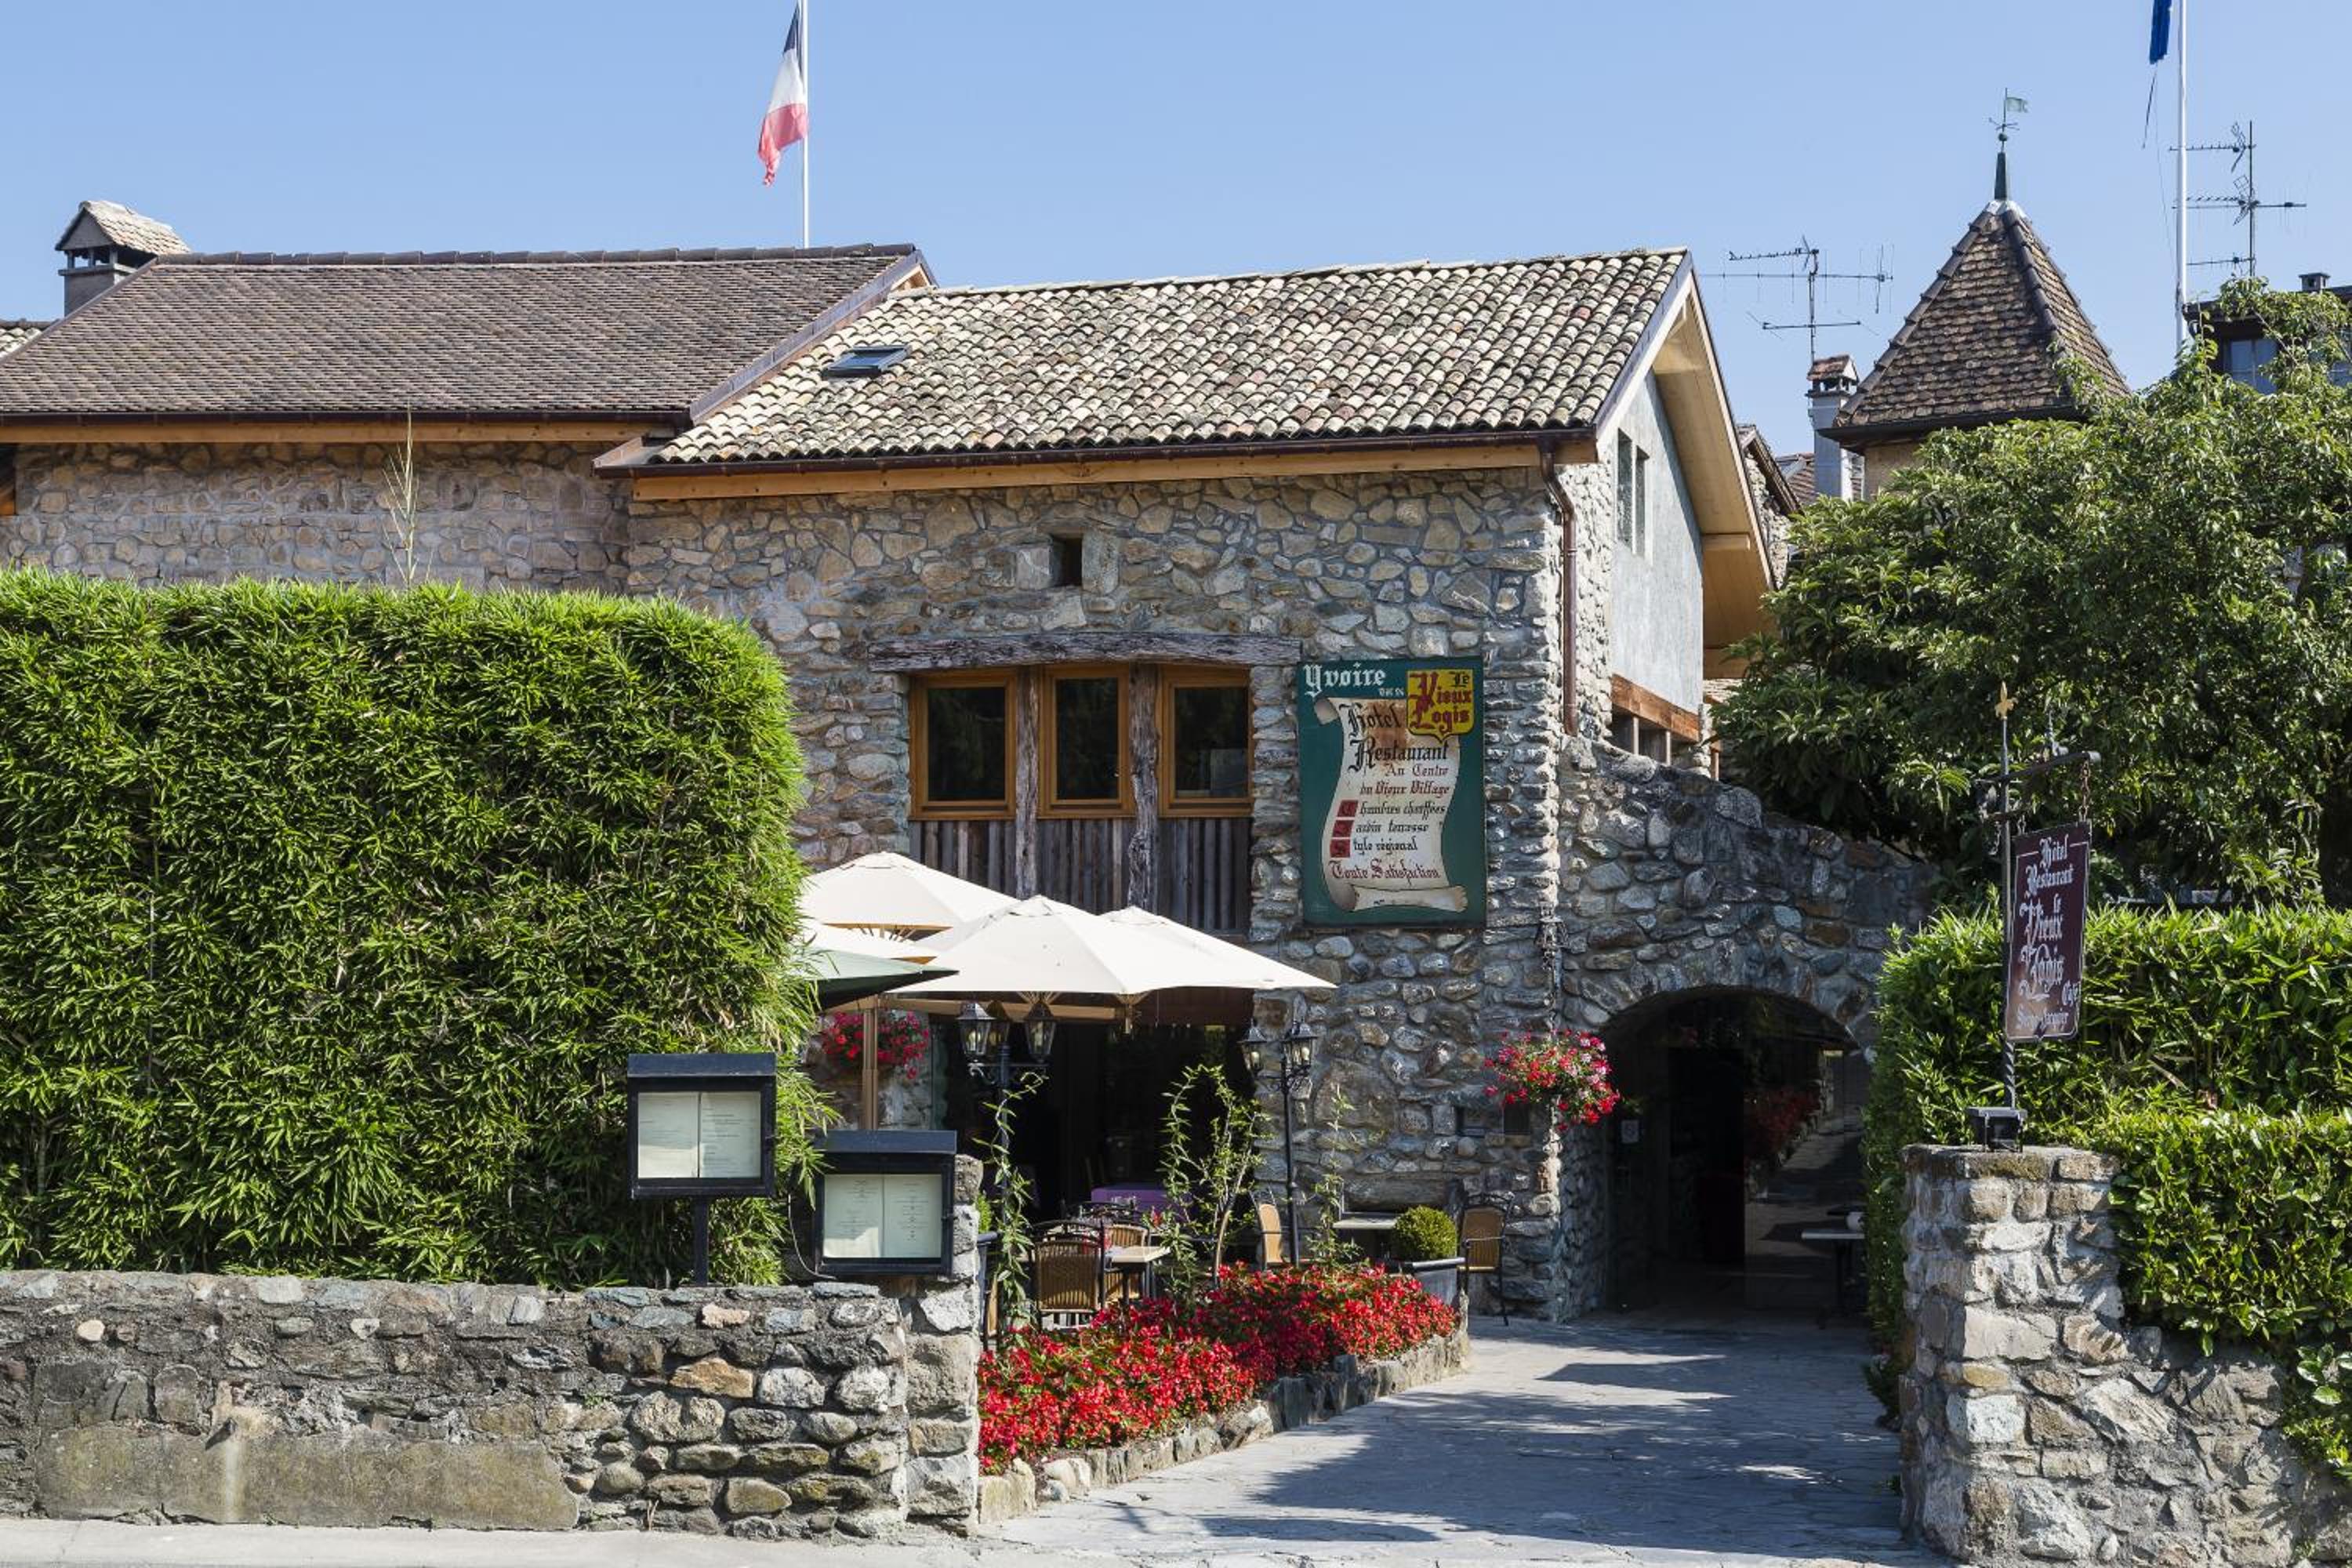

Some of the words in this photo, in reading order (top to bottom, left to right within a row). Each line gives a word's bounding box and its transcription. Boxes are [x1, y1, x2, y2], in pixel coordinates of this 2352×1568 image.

[1305, 662, 1387, 696] Yvoire
[1409, 672, 1472, 706] Vieux
[1449, 670, 1471, 688] Le
[1410, 695, 1471, 735] Logis
[1348, 736, 1450, 773] Restaurant
[1412, 764, 1450, 777] Centre
[1410, 780, 1450, 798] Village
[2024, 863, 2074, 898] Restaurant
[2019, 898, 2063, 946] Vieux
